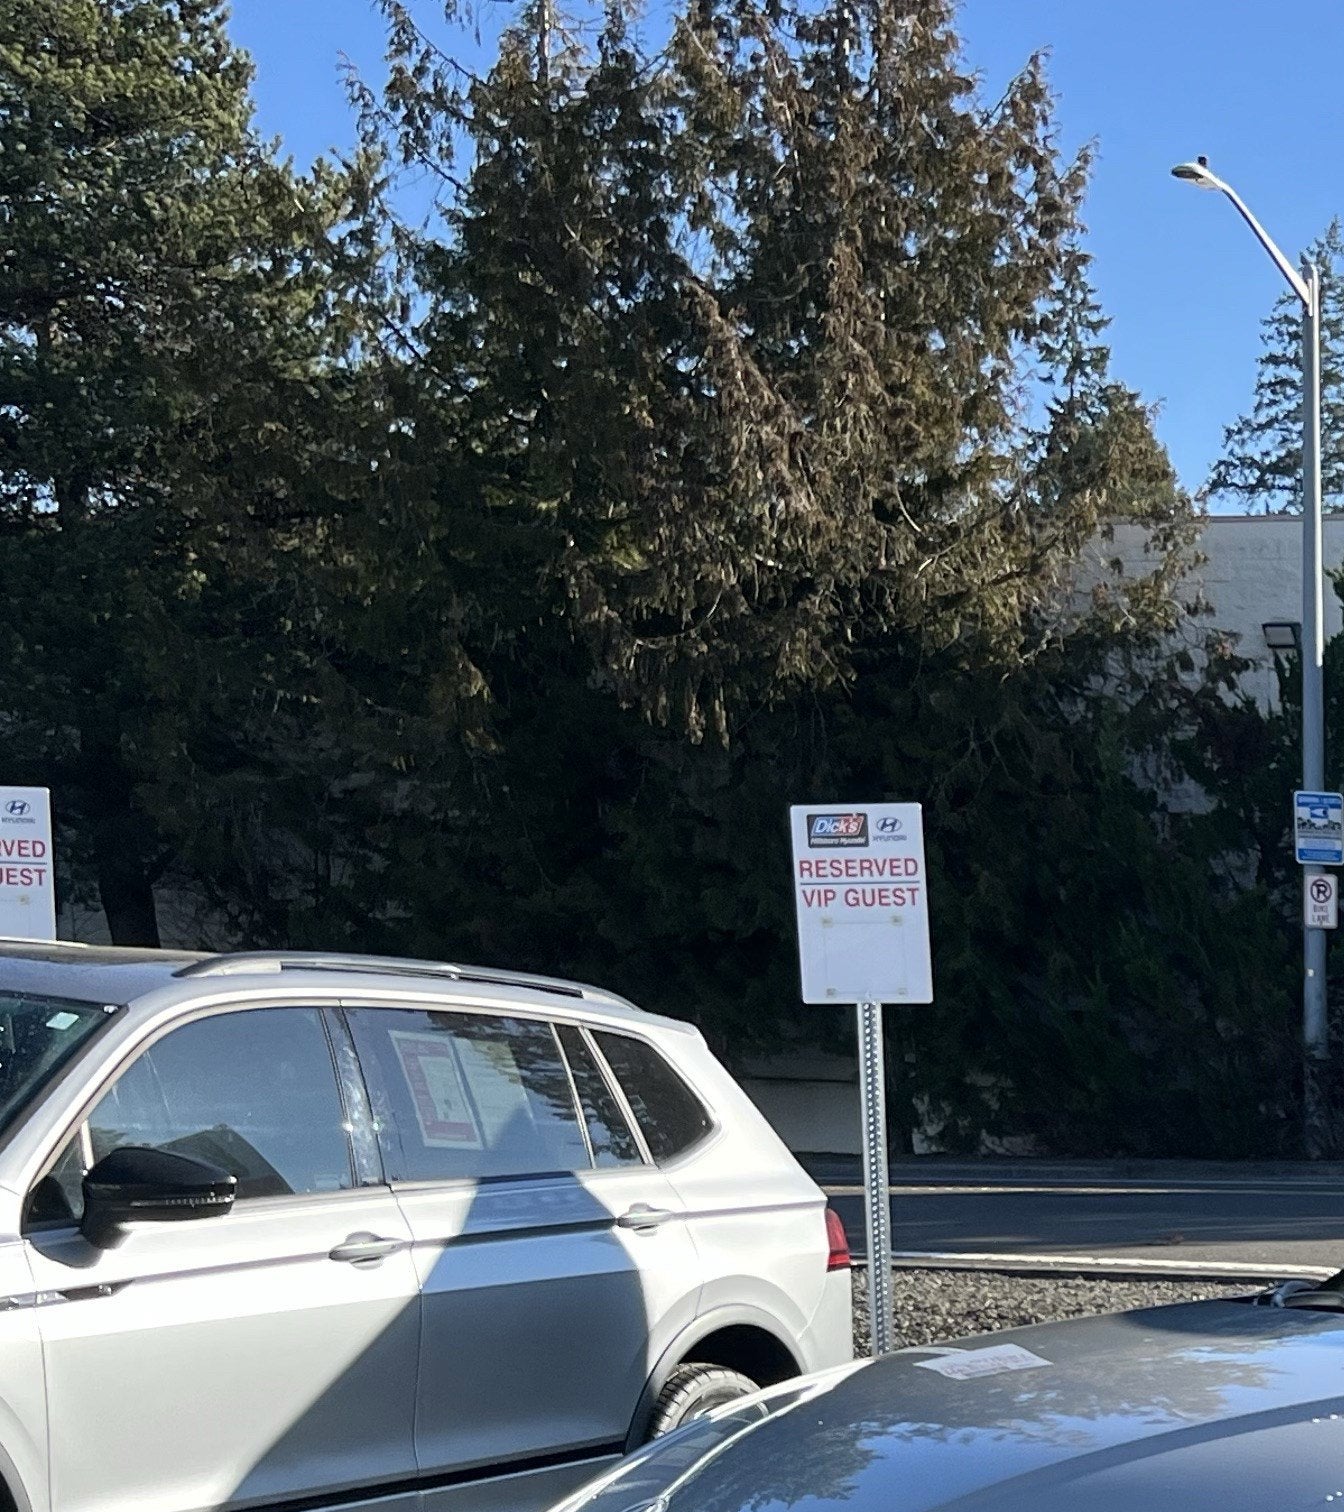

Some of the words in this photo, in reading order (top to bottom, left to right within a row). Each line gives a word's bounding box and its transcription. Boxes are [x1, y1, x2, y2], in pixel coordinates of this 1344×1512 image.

[0, 840, 46, 858] VED
[799, 858, 918, 878] RESERVED
[802, 889, 837, 908] VIP
[844, 888, 920, 907] GUEST
